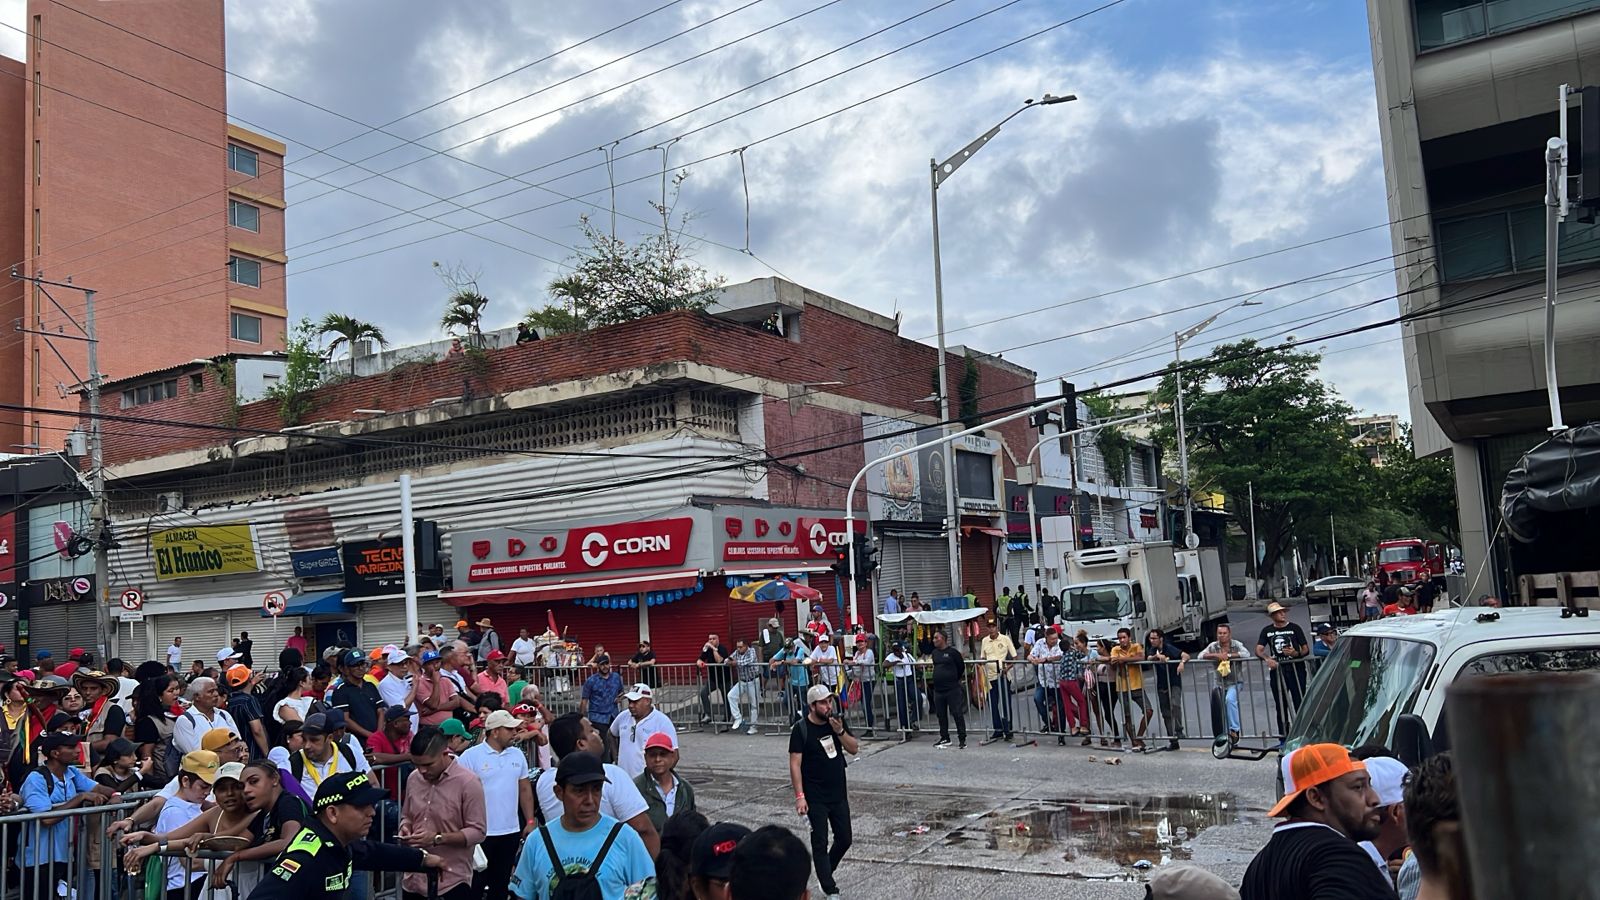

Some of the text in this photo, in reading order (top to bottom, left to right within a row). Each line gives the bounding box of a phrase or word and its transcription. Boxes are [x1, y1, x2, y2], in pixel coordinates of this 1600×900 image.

[165, 529, 198, 544] ALMACÉN
[613, 534, 670, 555] CORN
[156, 544, 222, 575] El Hunico
[361, 547, 404, 563] TECN
